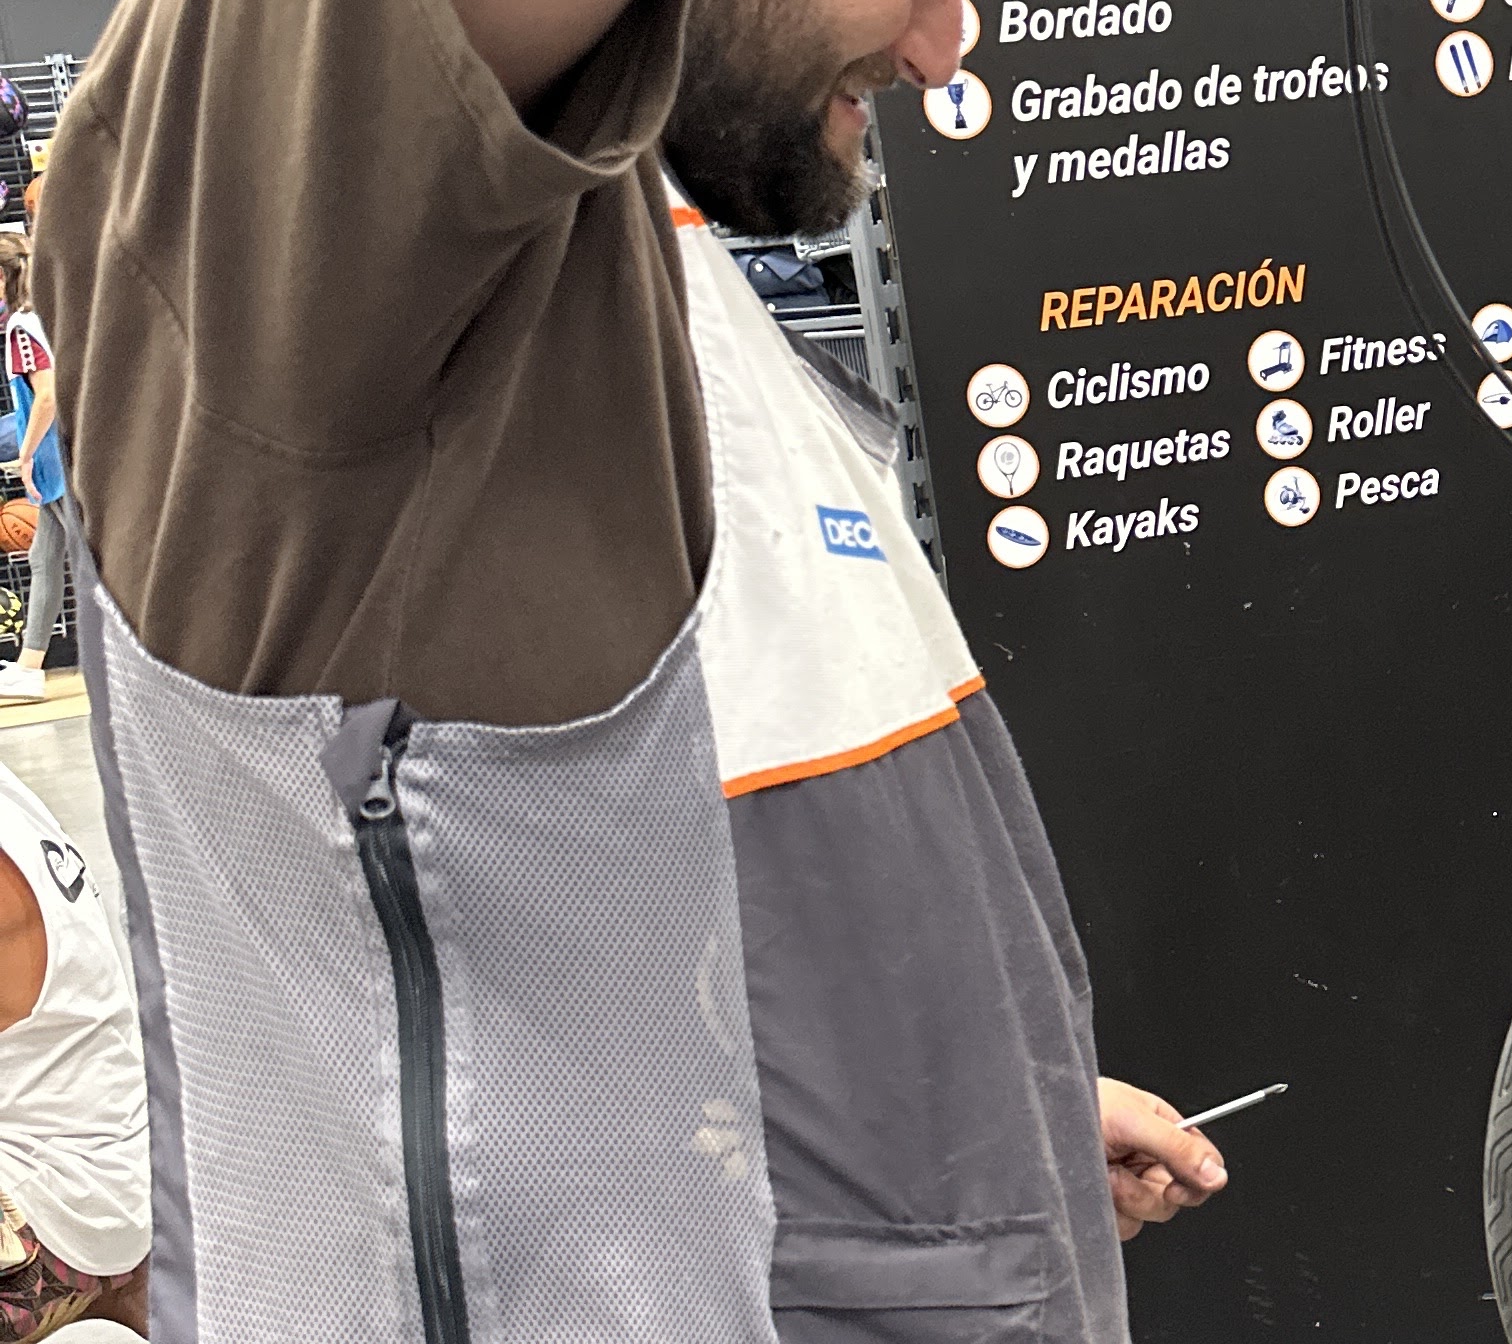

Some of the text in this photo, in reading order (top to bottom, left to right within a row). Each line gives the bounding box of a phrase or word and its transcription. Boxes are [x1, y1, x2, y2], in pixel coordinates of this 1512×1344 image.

[1011, 56, 1389, 122] Grabado de trofeos
[1011, 129, 1231, 198] y medallas
[1040, 259, 1306, 332] REPARACIÓN
[1319, 332, 1447, 375] Fitness
[1047, 362, 1210, 409] Ciclismo
[1327, 396, 1431, 443] Roller
[1056, 429, 1231, 482] Raquetas
[1335, 468, 1440, 509] Pesca
[824, 517, 878, 549] DEC
[1065, 497, 1200, 553] Kayaks
